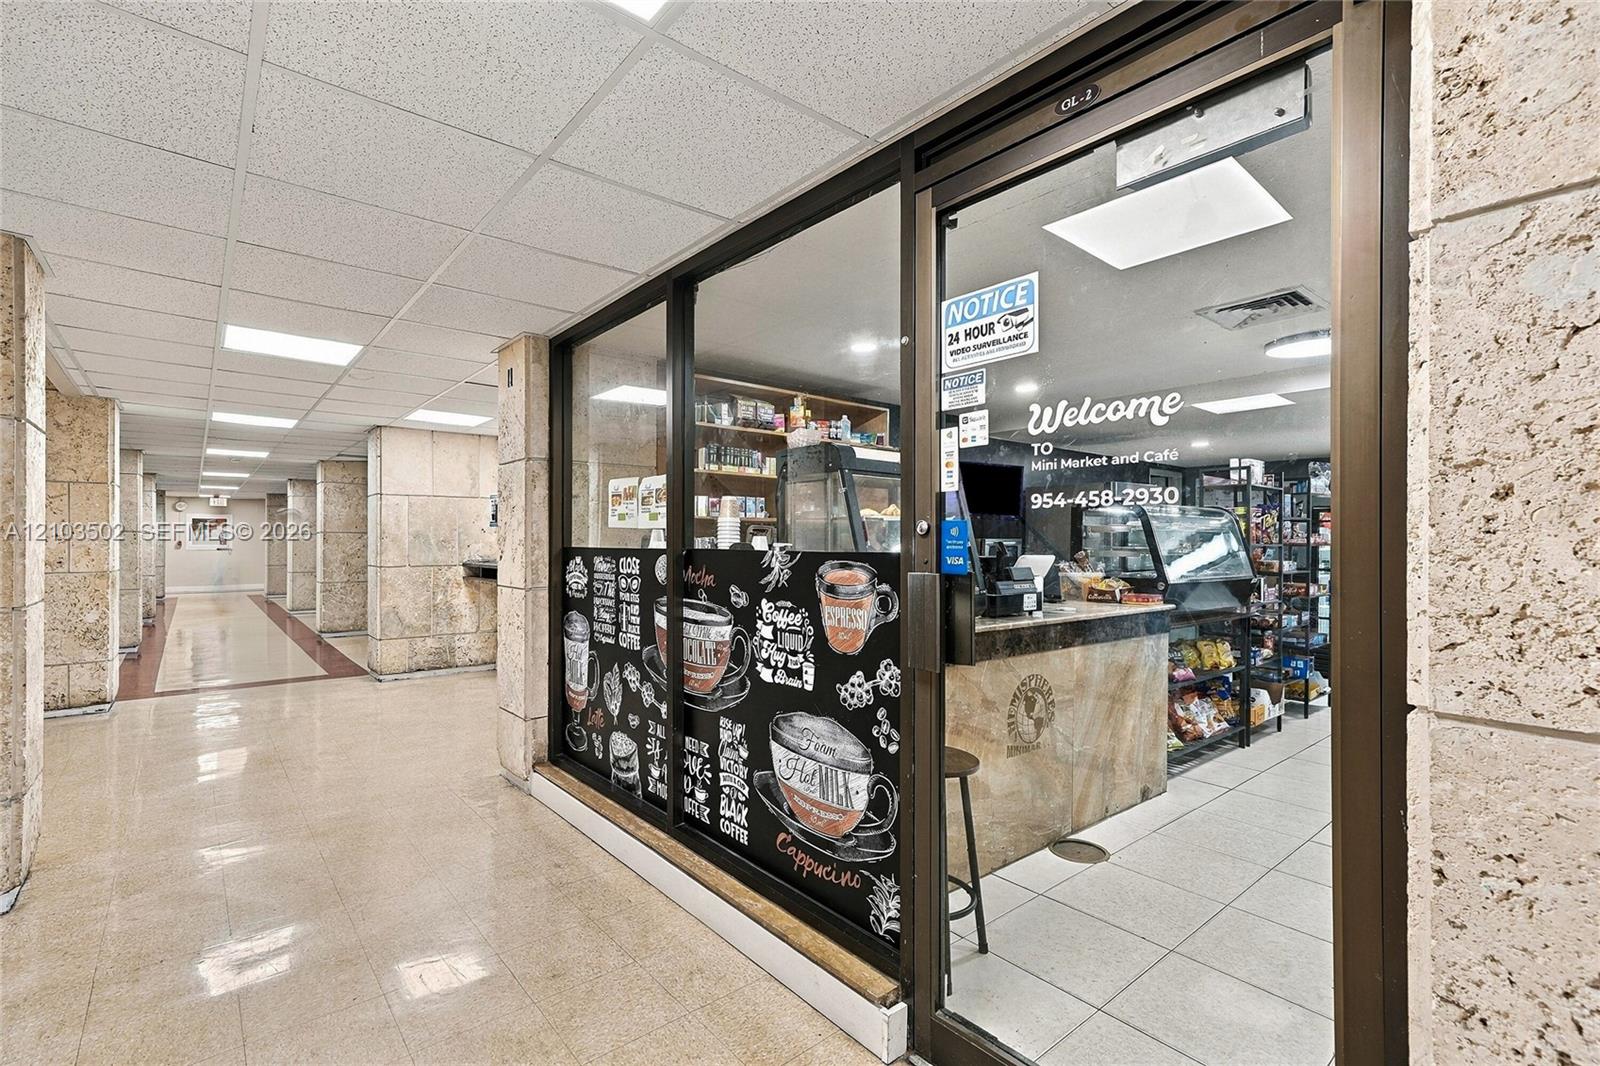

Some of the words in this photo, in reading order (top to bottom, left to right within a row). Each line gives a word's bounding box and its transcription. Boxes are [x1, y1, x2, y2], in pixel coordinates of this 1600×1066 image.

[948, 281, 1029, 326] NOTICE
[948, 332, 960, 346] 24
[964, 322, 996, 342] HOUR
[949, 346, 971, 357] VIDEO
[972, 332, 1029, 352] SURVEILLANCE
[944, 373, 984, 389] NOTICE
[1028, 392, 1184, 436] Welcome
[1031, 442, 1054, 457] TO
[1031, 460, 1057, 472] Mini
[1060, 456, 1107, 469] Market
[1111, 452, 1139, 465] and
[1143, 447, 1179, 464] Café
[1030, 486, 1180, 510] 954-458-2930
[619, 557, 641, 575] CLOSE
[945, 556, 964, 565] VISA
[760, 598, 803, 629] Coffee
[825, 606, 867, 631] ESPRESSO
[618, 631, 641, 650] COFFEE
[683, 637, 717, 666] OCOLATE
[777, 631, 804, 652] LIQUID
[761, 640, 787, 668] Hug
[774, 668, 803, 689] Brain
[719, 716, 733, 730] RISE
[733, 723, 747, 742] UP!
[799, 727, 837, 758] Foam
[719, 756, 749, 780] VICTORY
[779, 757, 815, 788] Hot
[817, 764, 854, 809] MILK
[719, 793, 749, 828] BLACK
[719, 816, 749, 846] COFFEE
[776, 832, 862, 889] Cappucino
